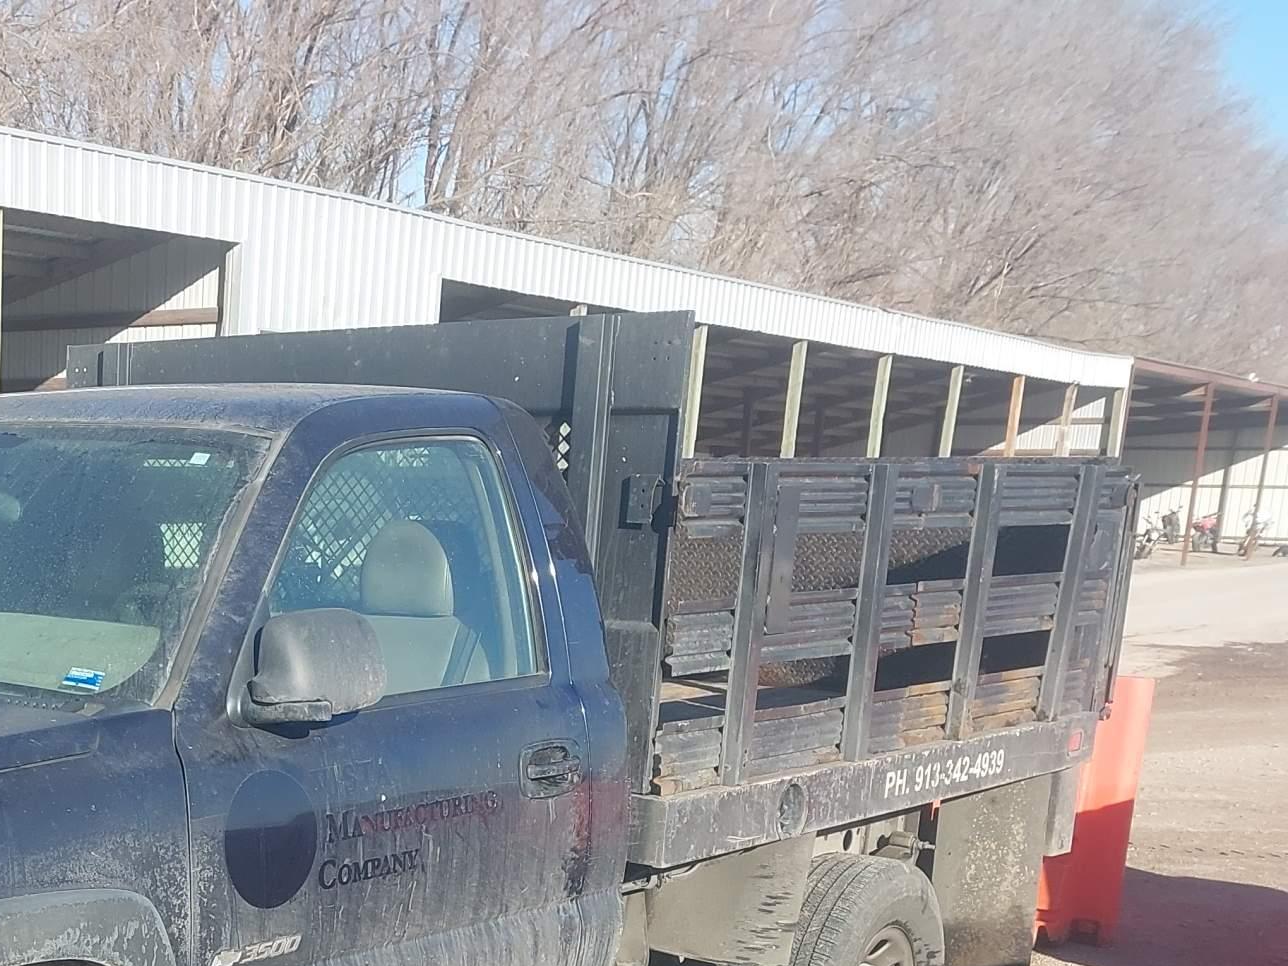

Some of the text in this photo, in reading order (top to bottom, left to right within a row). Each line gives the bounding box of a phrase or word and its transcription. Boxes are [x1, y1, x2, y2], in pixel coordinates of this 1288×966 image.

[884, 748, 1005, 799] PH. 913-342-4939
[318, 848, 422, 890] COMPANY
[239, 935, 302, 965] 3500
